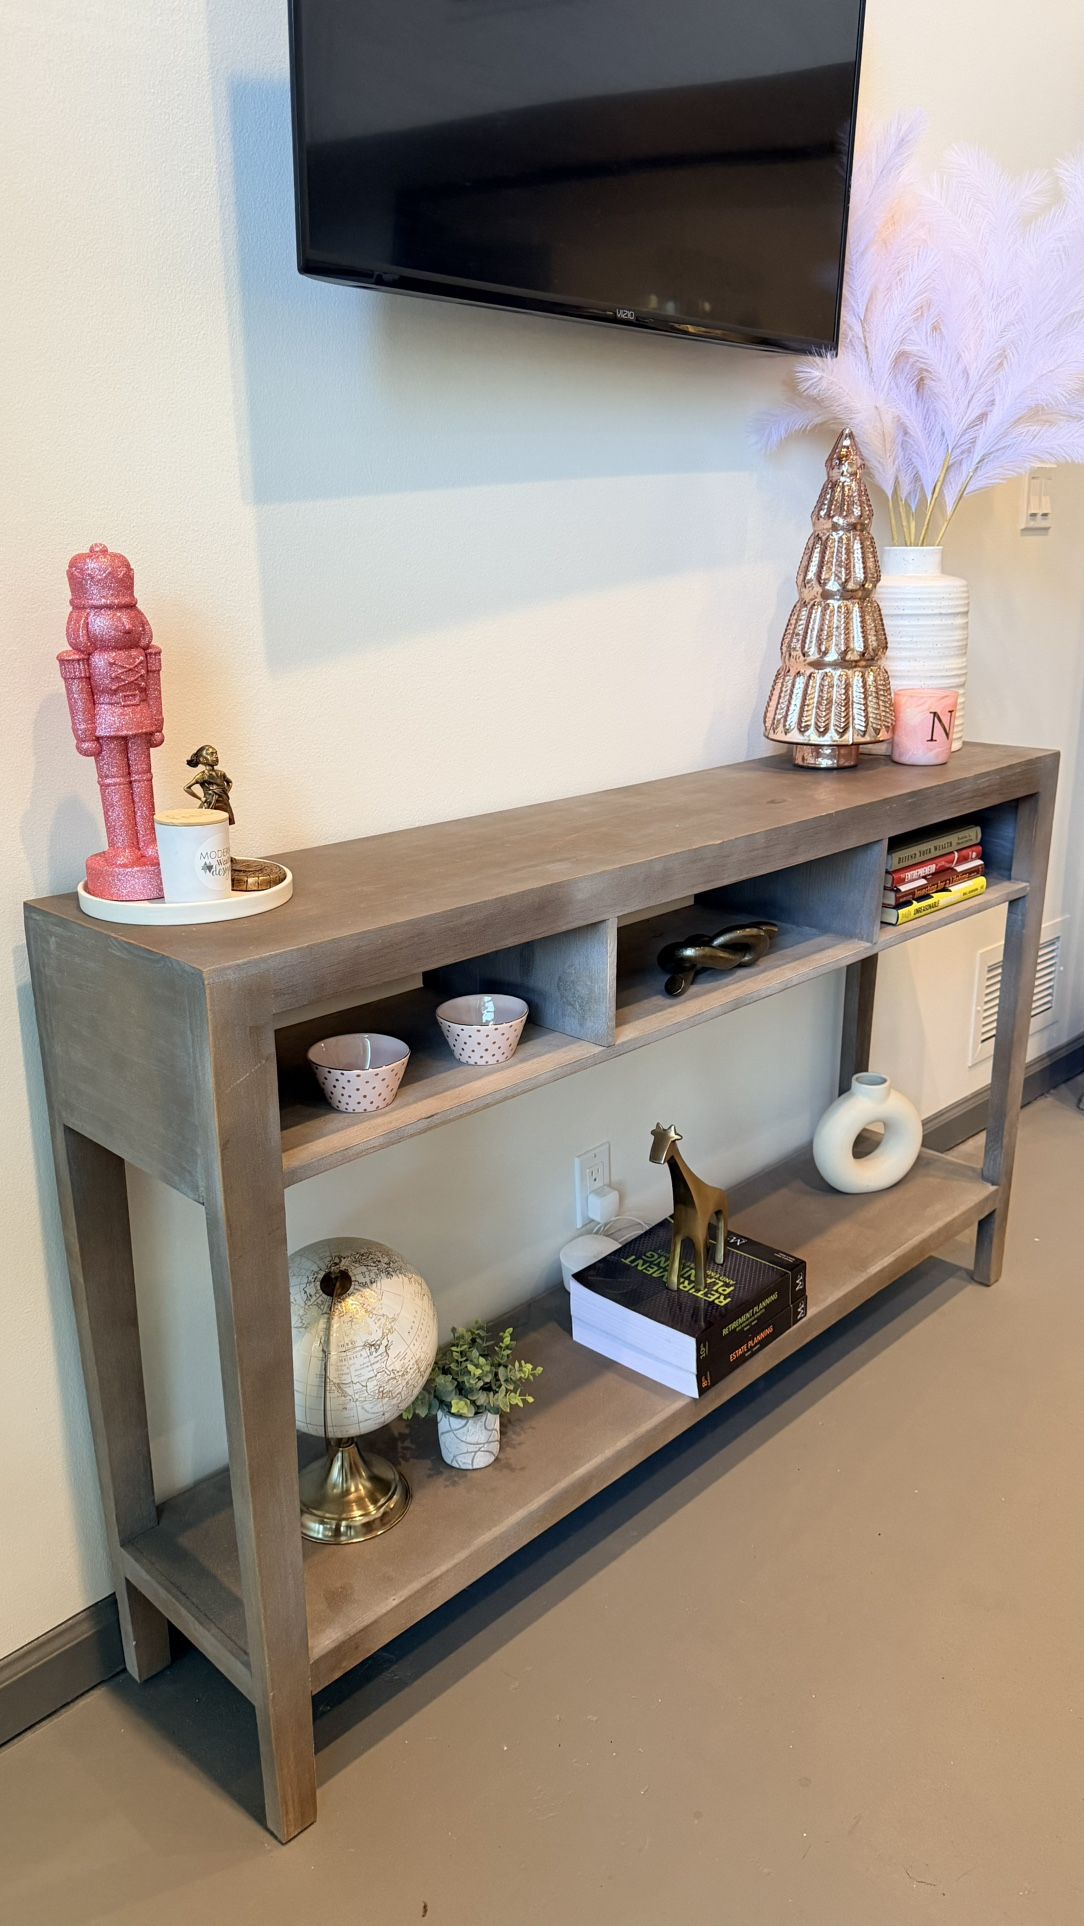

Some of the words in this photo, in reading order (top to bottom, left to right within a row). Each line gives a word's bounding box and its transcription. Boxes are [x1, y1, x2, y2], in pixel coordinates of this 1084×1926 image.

[617, 309, 635, 320] VIZIO
[926, 709, 954, 742] N
[897, 851, 917, 865] DEFEND
[919, 848, 932, 857] YOUR
[934, 841, 953, 852] WEALTH
[915, 884, 937, 898] Investing
[621, 1255, 731, 1306] RETRMENT
[642, 1251, 735, 1295] PLANNG
[722, 1309, 753, 1337] RETIREMENT
[753, 1291, 778, 1316] PLANNING
[729, 1343, 748, 1362] ESTATE
[748, 1325, 774, 1349] PLANNING
